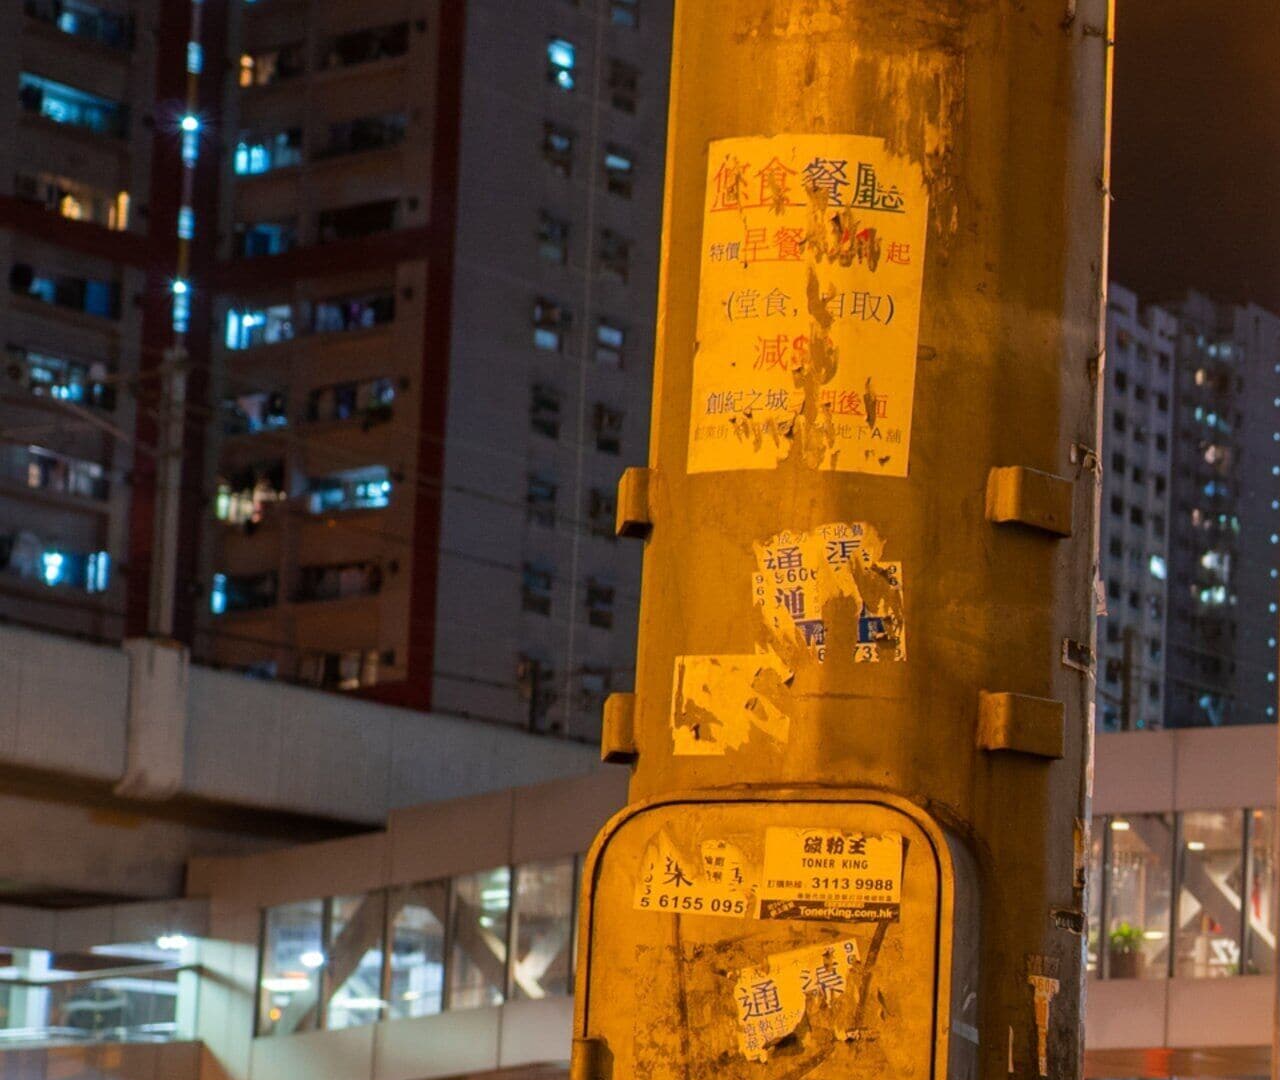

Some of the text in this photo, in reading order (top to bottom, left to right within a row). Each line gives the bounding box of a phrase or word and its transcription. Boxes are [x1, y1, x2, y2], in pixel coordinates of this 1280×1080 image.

[886, 242, 911, 265] 起
[801, 858, 869, 870] TONER KING
[811, 876, 850, 890] 3113
[855, 878, 894, 892] 9988
[799, 905, 894, 919] TonerKing.com.hk
